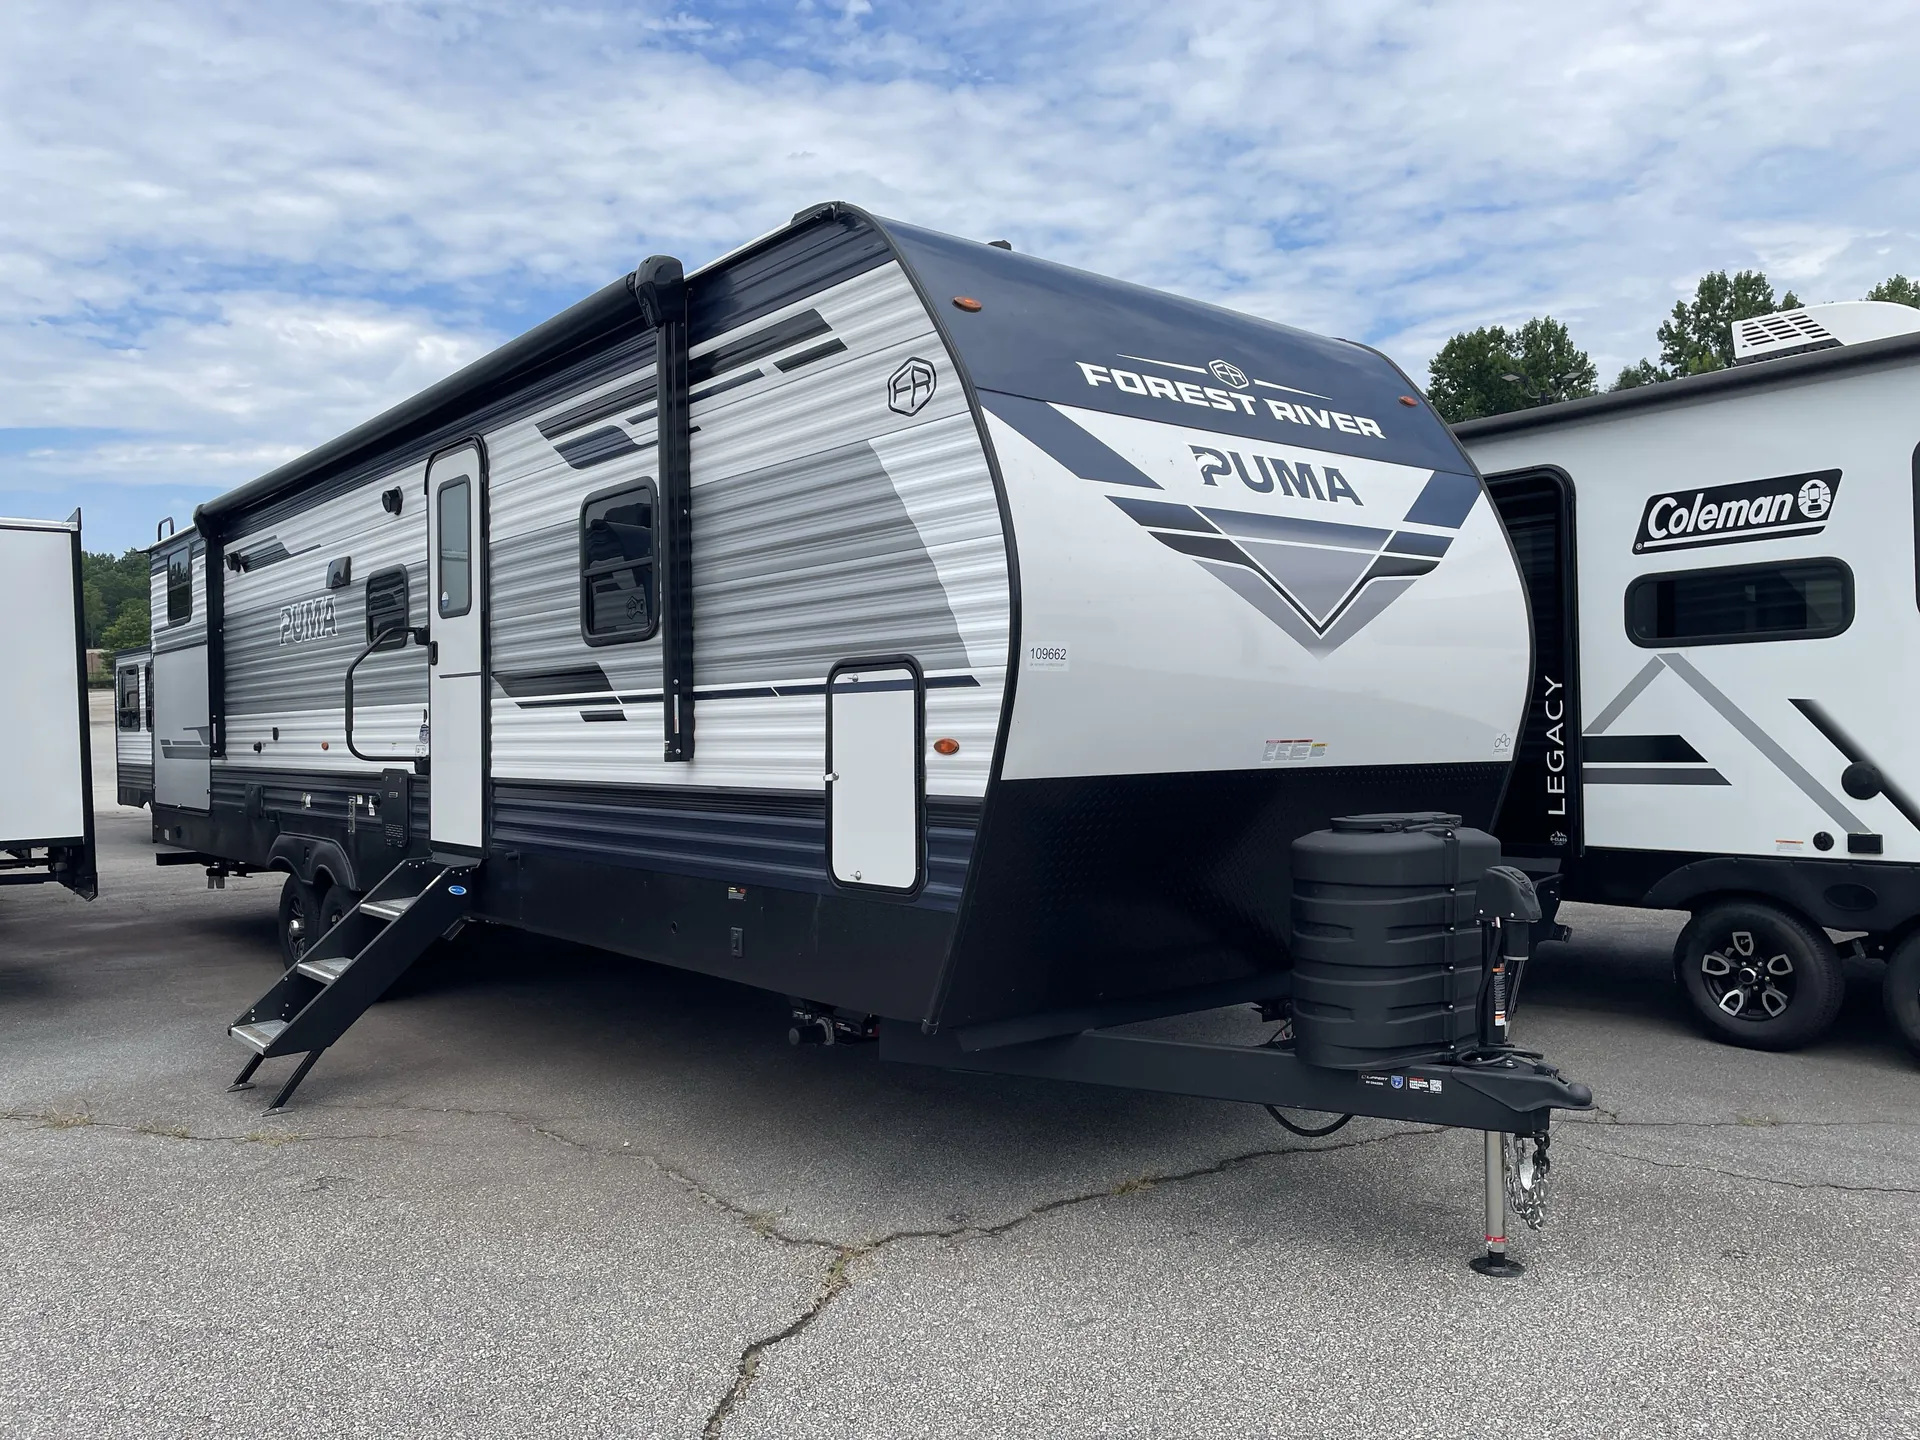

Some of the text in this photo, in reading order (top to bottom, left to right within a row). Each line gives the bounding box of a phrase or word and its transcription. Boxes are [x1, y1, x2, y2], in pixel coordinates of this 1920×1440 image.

[1075, 361, 1386, 439] FOREST RIVER
[1187, 444, 1364, 507] PUMA
[1648, 493, 1794, 539] Coleman
[280, 595, 338, 646] PUMA
[1030, 647, 1067, 660] 109662
[1545, 675, 1566, 815] LEGACY
